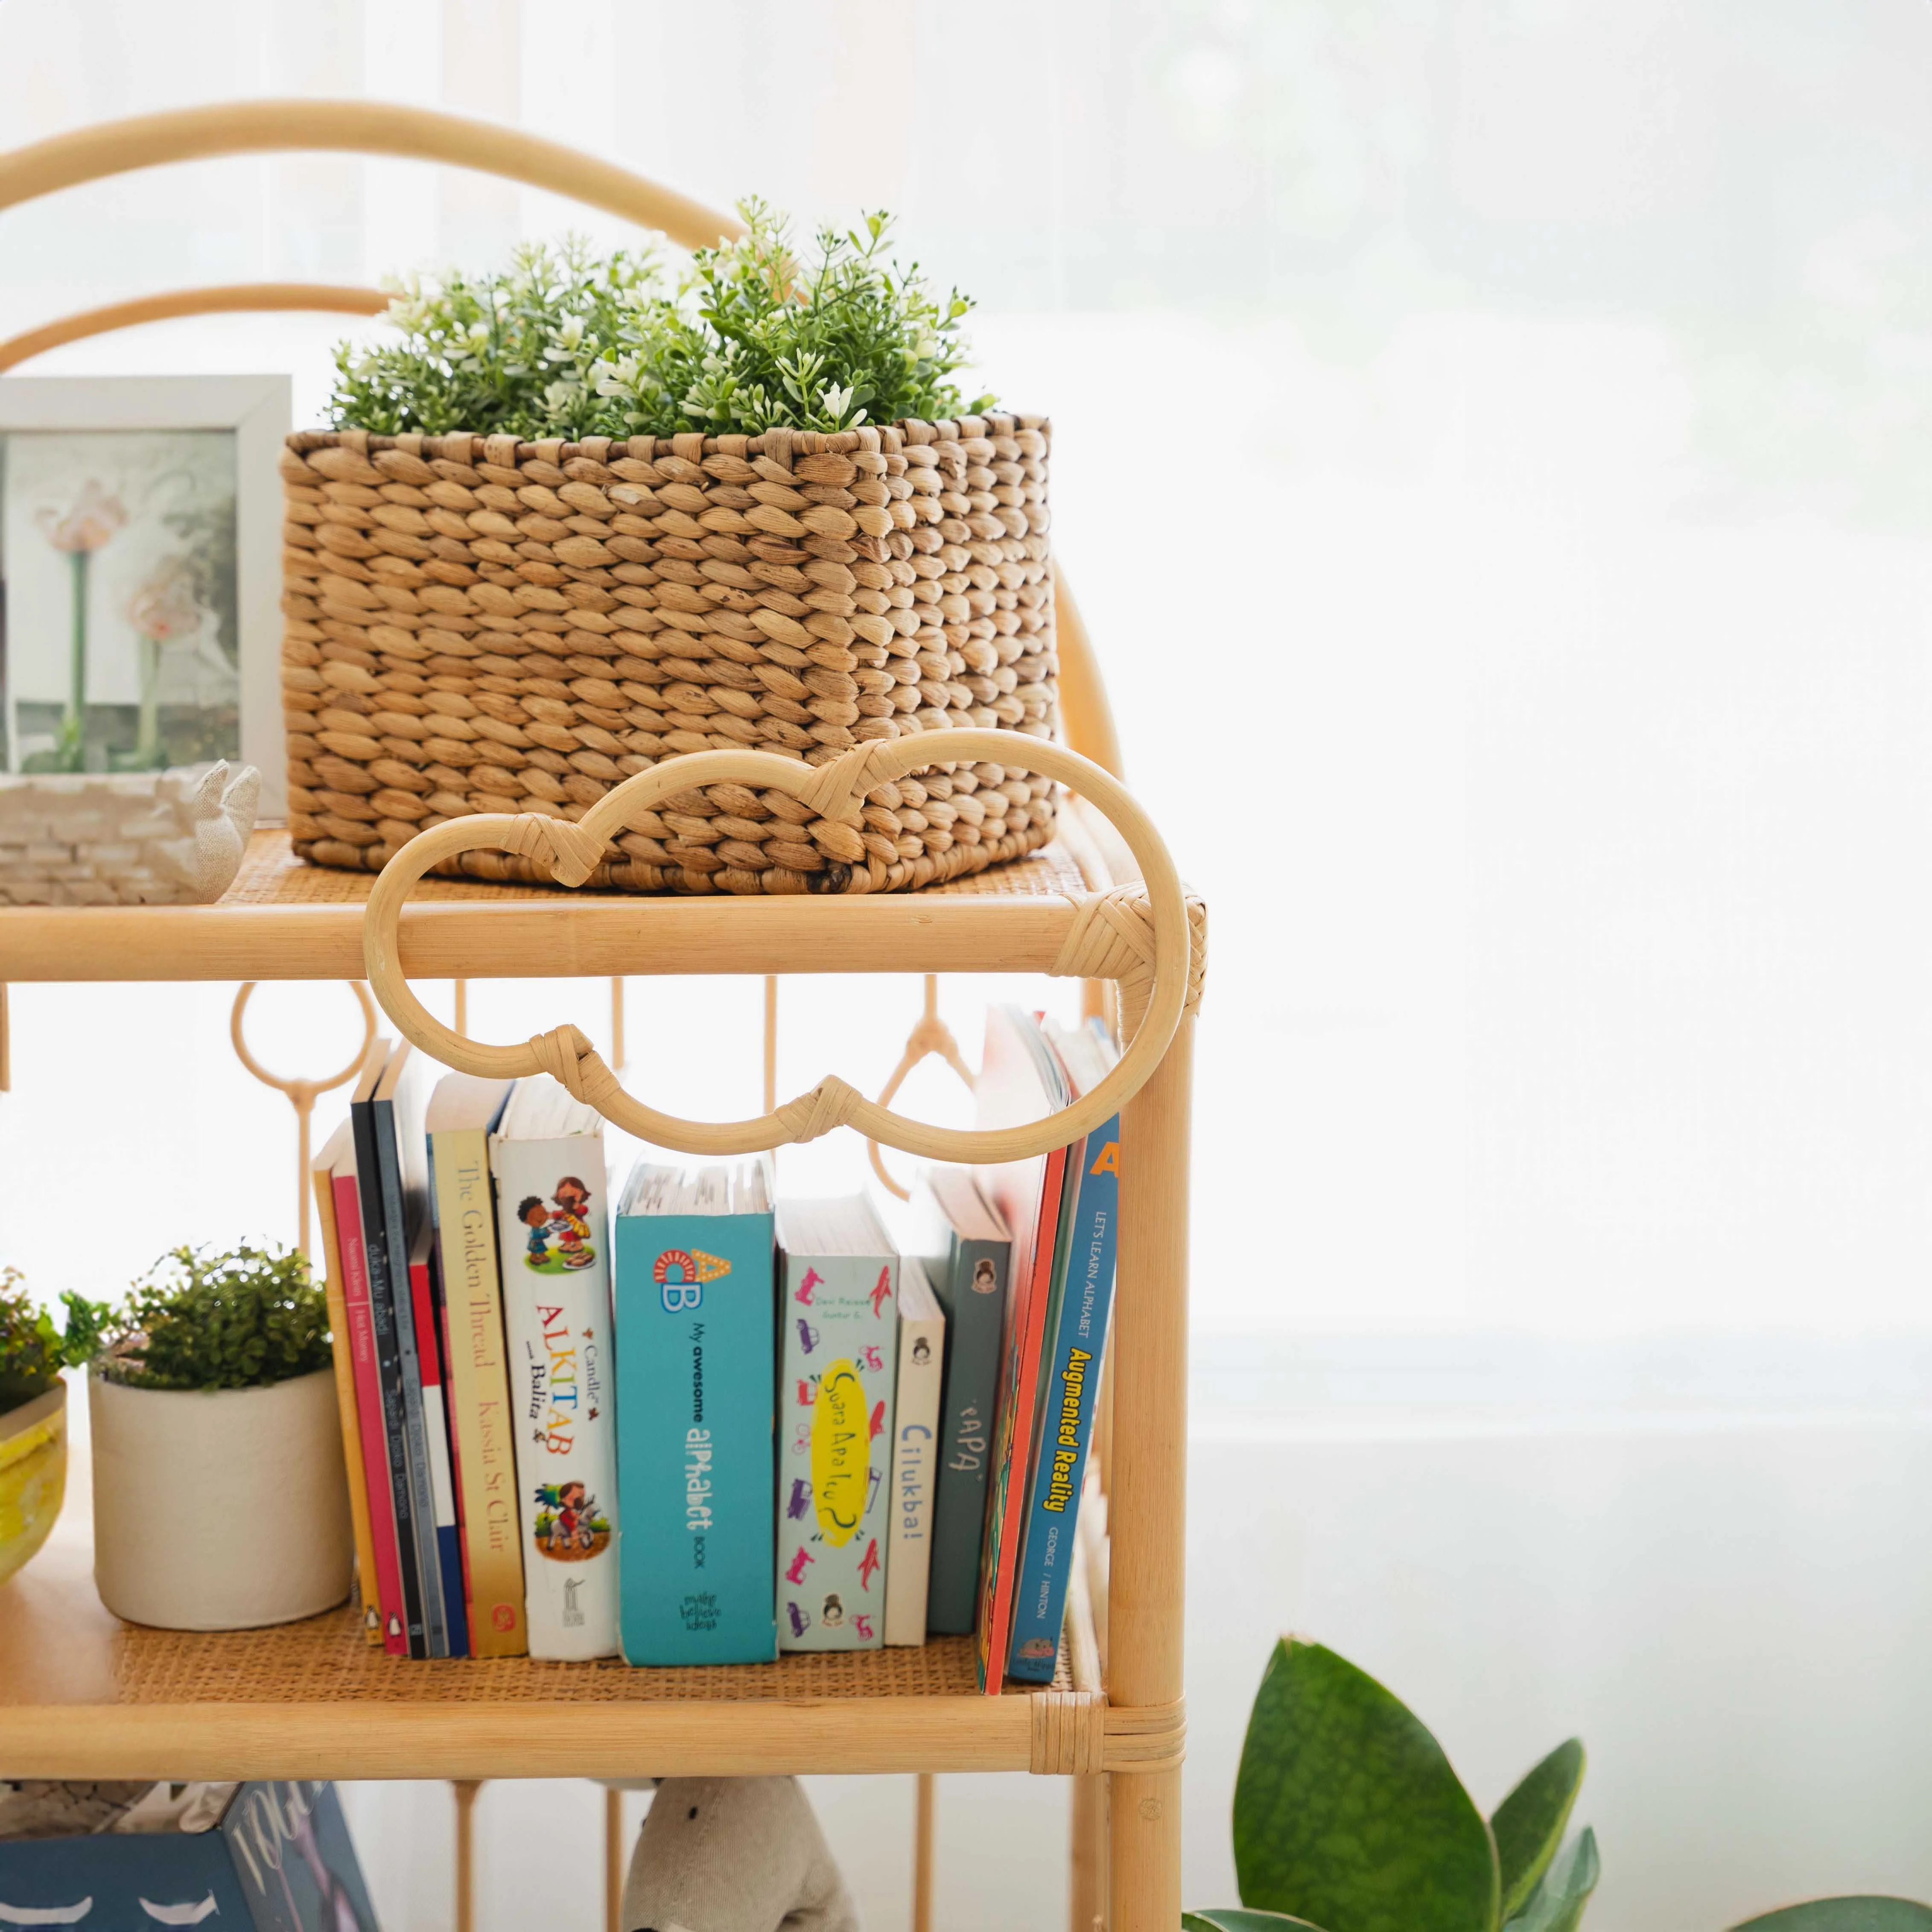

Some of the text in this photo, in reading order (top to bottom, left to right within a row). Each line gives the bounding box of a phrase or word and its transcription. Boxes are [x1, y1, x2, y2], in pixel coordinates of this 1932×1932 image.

[457, 1160, 495, 1367] The Golden Thread
[1078, 1211, 1106, 1338] LET'S LEARN ALPHABET
[689, 1322, 706, 1343] My
[528, 1364, 547, 1419] Balita
[536, 1305, 578, 1455] ALKITAB
[693, 1346, 703, 1423] awesome
[825, 1372, 855, 1426] Suara
[831, 1433, 856, 1467] Apa
[1042, 1346, 1092, 1513] Augmented Reality
[478, 1401, 509, 1551] Kassia St Clair
[685, 1428, 712, 1530] alphabet
[901, 1424, 932, 1539] Cilukba!
[1044, 1526, 1059, 1567] GEORGE
[1037, 1581, 1051, 1619] HINTON
